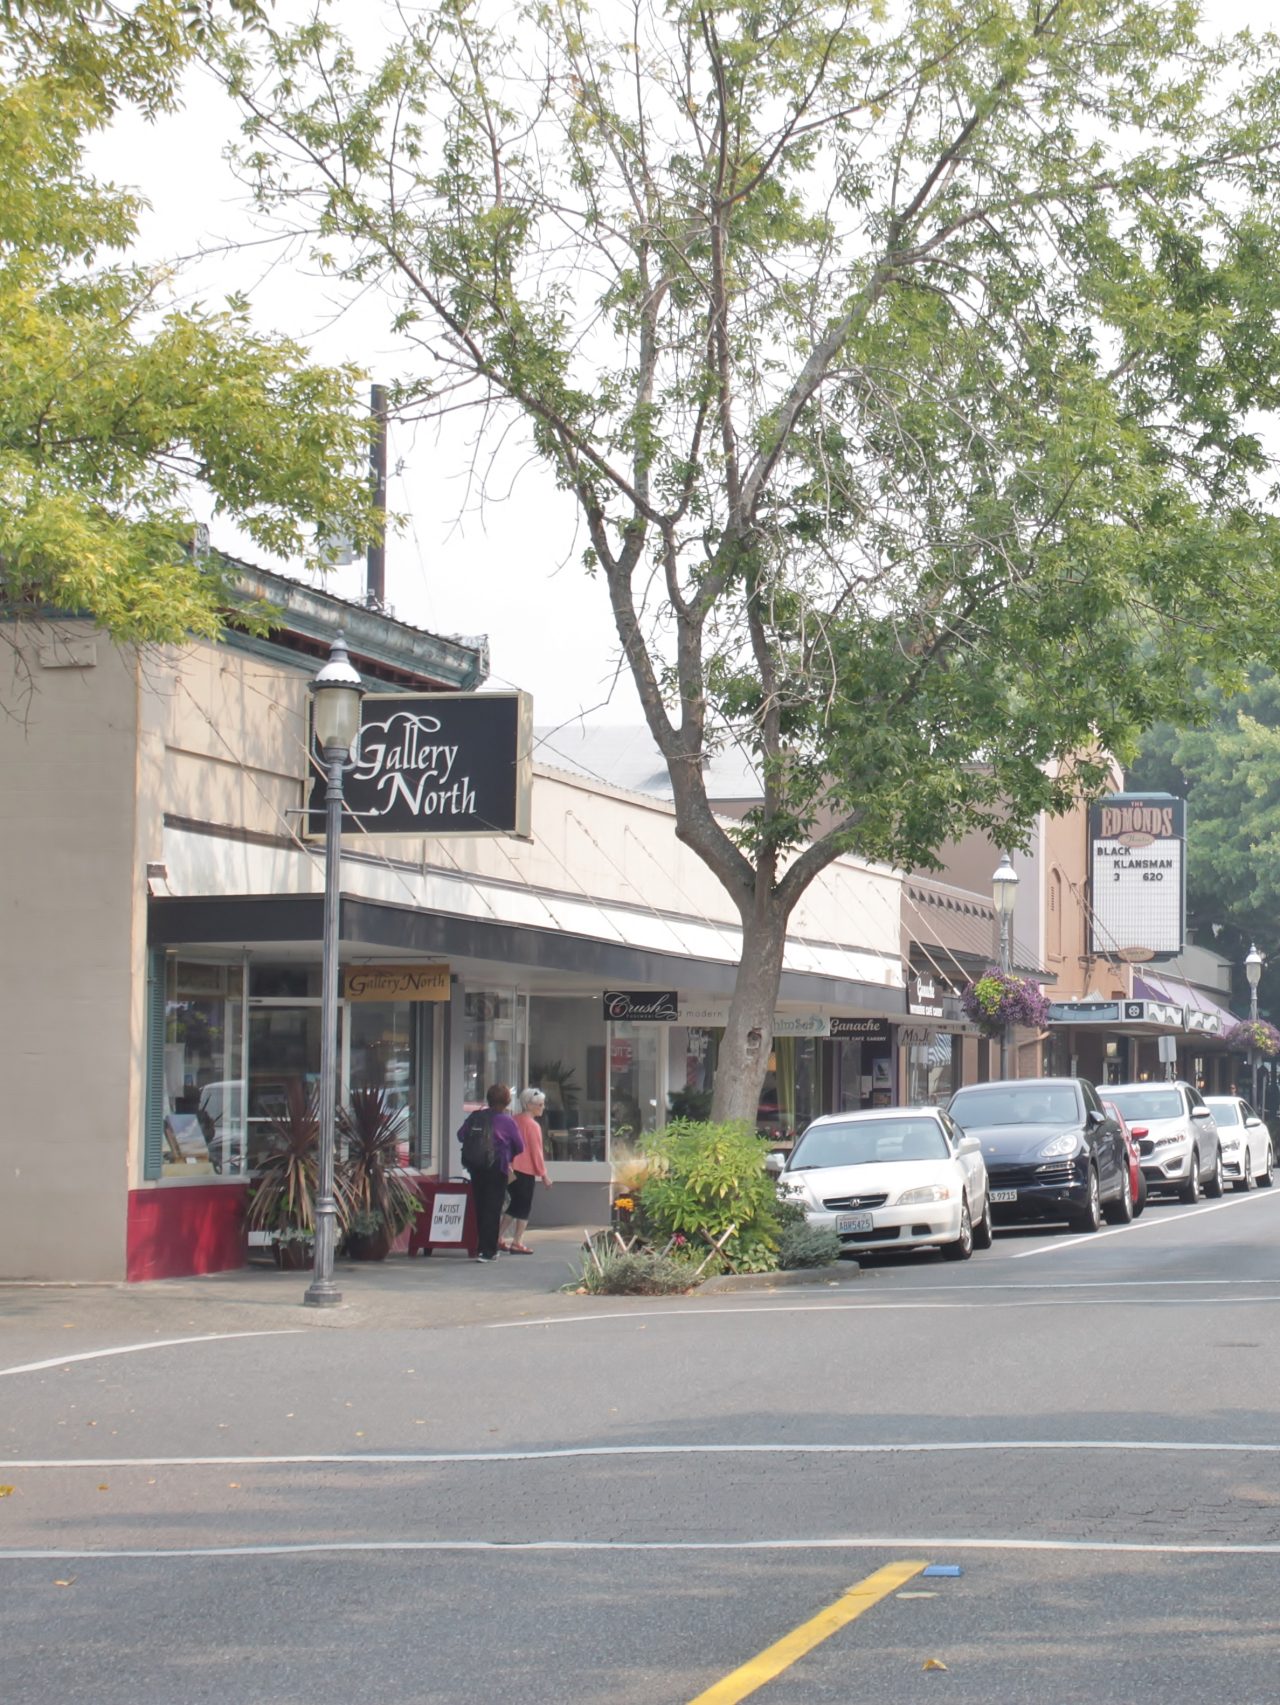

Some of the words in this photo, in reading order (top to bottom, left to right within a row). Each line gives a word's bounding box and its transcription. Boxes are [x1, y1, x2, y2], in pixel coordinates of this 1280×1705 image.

[350, 712, 458, 784] Gallery
[377, 771, 477, 815] North
[1101, 807, 1172, 837] EDMONDS
[1097, 847, 1131, 856] BLACK
[1113, 860, 1172, 869] KLANSMAN
[1113, 873, 1120, 882] 3
[1143, 873, 1163, 882] 620
[349, 970, 399, 997] Gallery
[400, 972, 446, 991] North
[604, 992, 677, 1020] Crush
[686, 1008, 722, 1018] modern
[830, 1019, 881, 1034] Ganache
[438, 1203, 461, 1213] ARTIST
[434, 1215, 443, 1224] ON
[445, 1215, 462, 1225] DUTY
